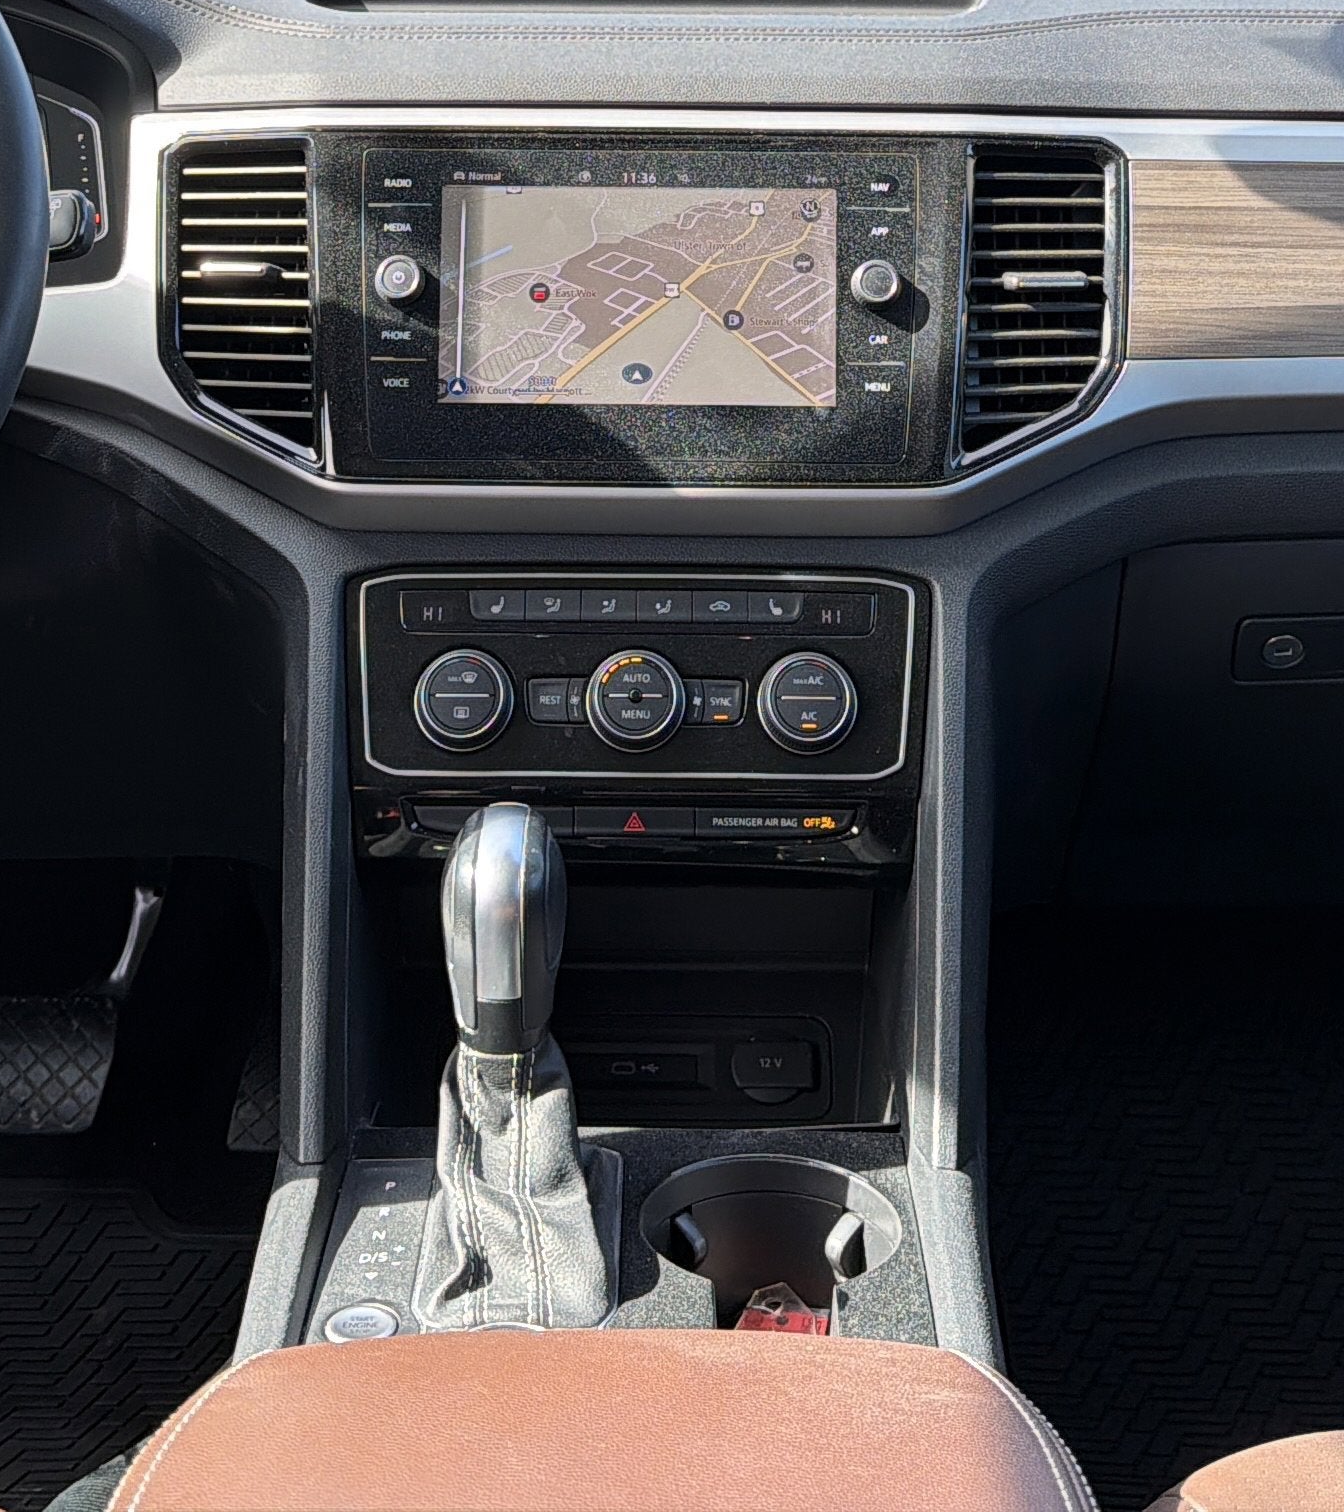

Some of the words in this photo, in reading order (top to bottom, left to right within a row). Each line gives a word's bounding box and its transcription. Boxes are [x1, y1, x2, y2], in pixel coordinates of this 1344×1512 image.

[468, 171, 502, 182] Normal
[621, 172, 657, 185] 11:36
[383, 177, 413, 188] RADIO
[870, 182, 890, 193] NAV
[383, 222, 413, 233] MEDIA
[870, 226, 889, 238] APP
[380, 329, 412, 340] PHONE
[868, 334, 888, 345] CAR
[382, 377, 411, 388] VOICE
[864, 382, 891, 392] MENU
[422, 606, 443, 622] HI
[821, 609, 841, 624] HI
[622, 672, 651, 684] AUTO
[539, 694, 562, 705] REST
[709, 696, 733, 707] SYNC
[620, 708, 652, 720] MENU
[800, 711, 818, 721] A/C
[712, 816, 763, 827] PASSENGER
[764, 817, 779, 827] AIR
[780, 817, 798, 828] BAG
[803, 817, 821, 828] OFF
[759, 1057, 771, 1068] 12
[773, 1057, 783, 1069] V
[384, 1180, 397, 1192] P
[378, 1206, 391, 1218] R
[371, 1229, 387, 1241] N
[358, 1251, 389, 1264] D/S
[342, 1320, 380, 1331] ENGINE
